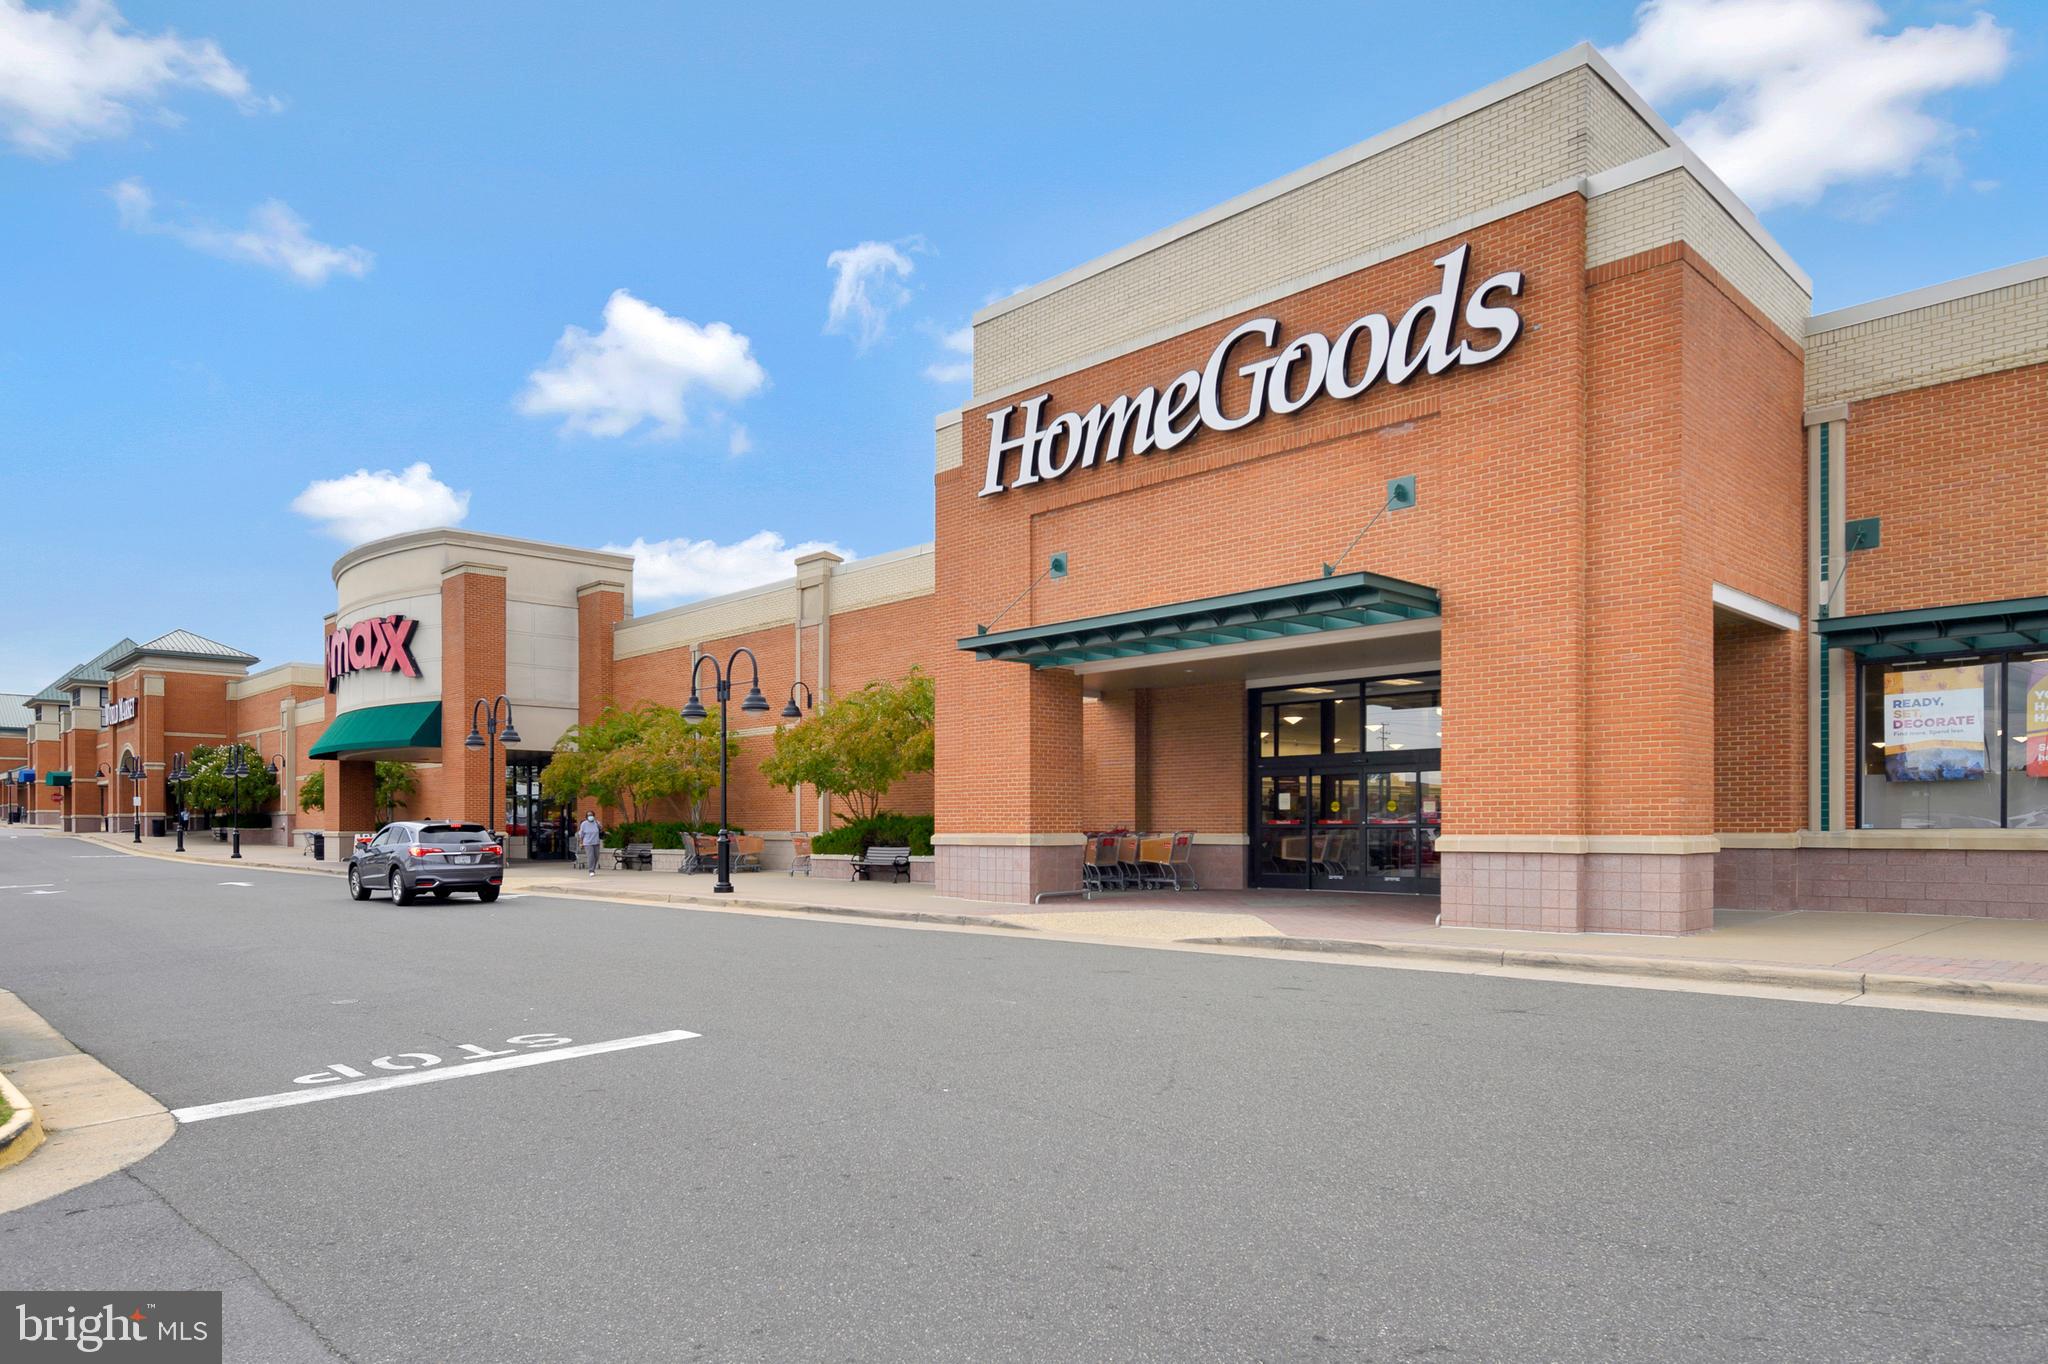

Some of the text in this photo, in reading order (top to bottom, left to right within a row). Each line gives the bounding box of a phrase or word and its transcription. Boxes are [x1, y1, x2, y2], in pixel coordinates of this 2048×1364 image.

[978, 243, 1523, 497] HomeGoods
[1893, 715, 1975, 729] DECORATE
[293, 1033, 573, 1084] STOP
